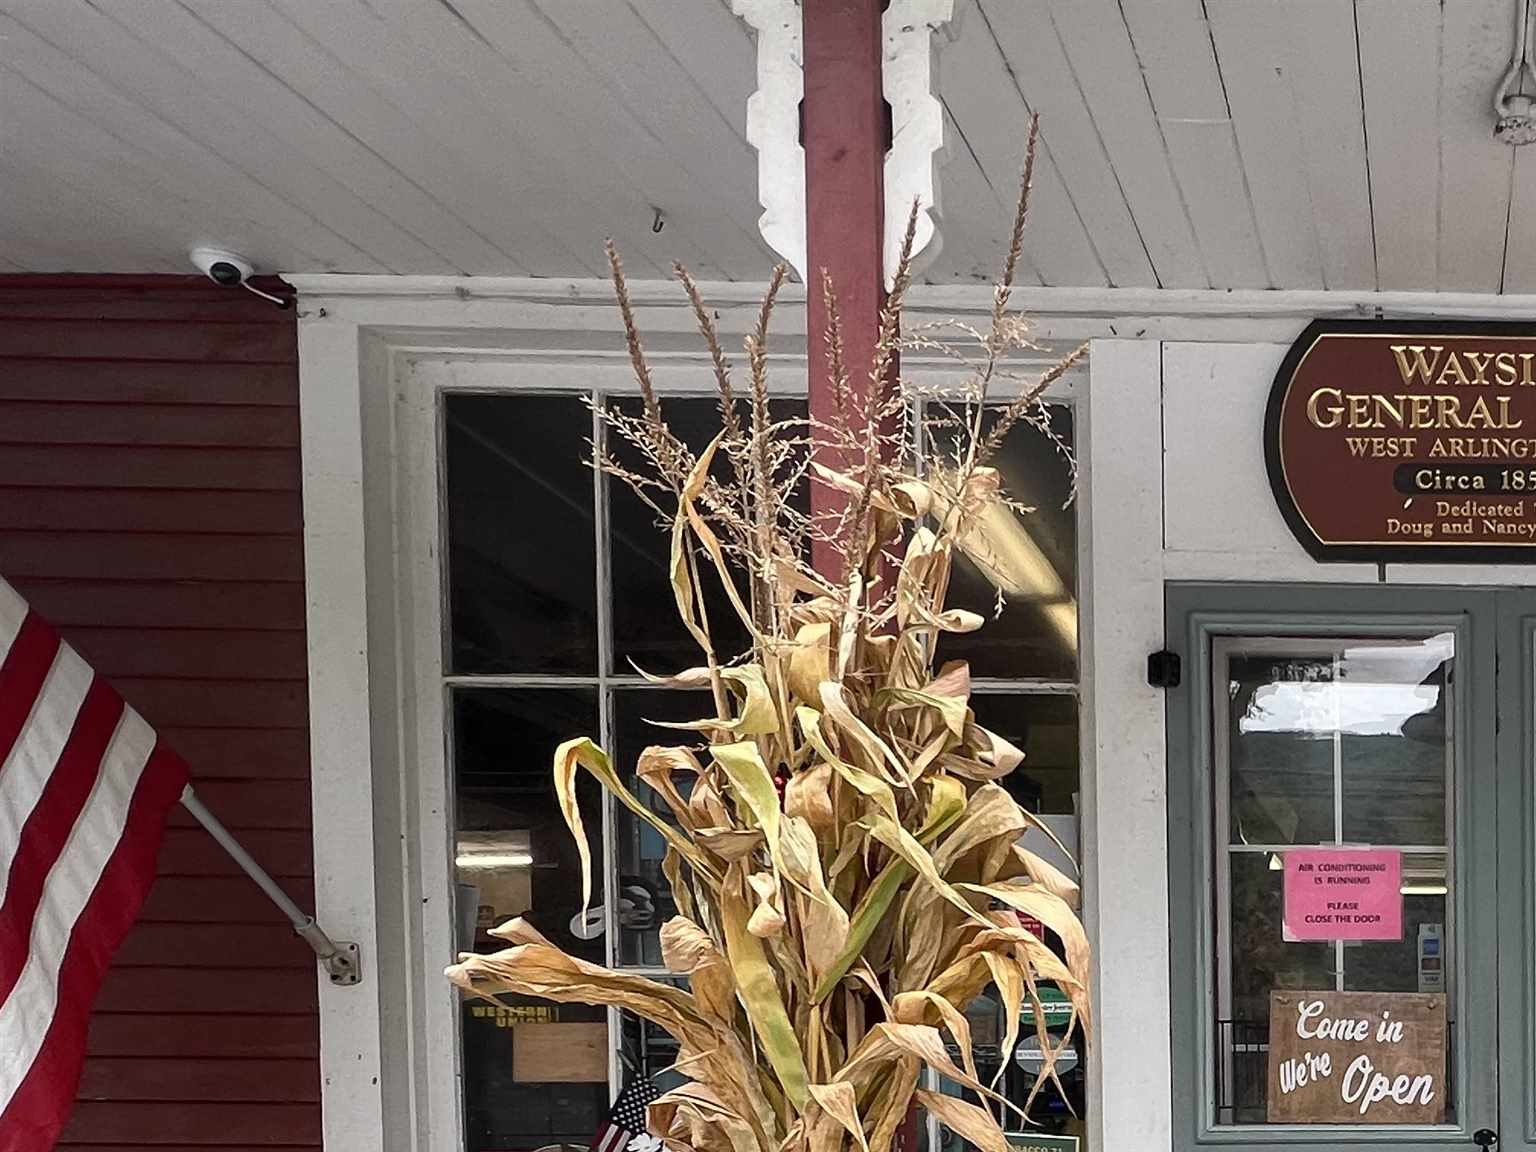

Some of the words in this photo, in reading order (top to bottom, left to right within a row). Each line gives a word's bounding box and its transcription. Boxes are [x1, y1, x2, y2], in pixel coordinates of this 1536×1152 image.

[1306, 387, 1523, 430] GENERAL
[1345, 438, 1418, 459] WEST
[1415, 470, 1486, 491] Circa
[1436, 501, 1525, 518] Dedicated
[1387, 519, 1433, 538] Doug
[1441, 519, 1474, 535] and
[1482, 520, 1536, 539] Nancy
[1298, 863, 1314, 872] AIR
[1318, 863, 1386, 872] CONDITIONING
[1327, 876, 1371, 885] RUNNING
[1327, 902, 1359, 910] PLEASE
[1305, 914, 1332, 924] CLOSE
[1335, 914, 1351, 923] THE
[1354, 914, 1381, 923] DOOR
[1297, 1000, 1369, 1041] Come
[1376, 1010, 1404, 1043] in
[1279, 1052, 1333, 1094] We're
[1341, 1055, 1435, 1114] Open
